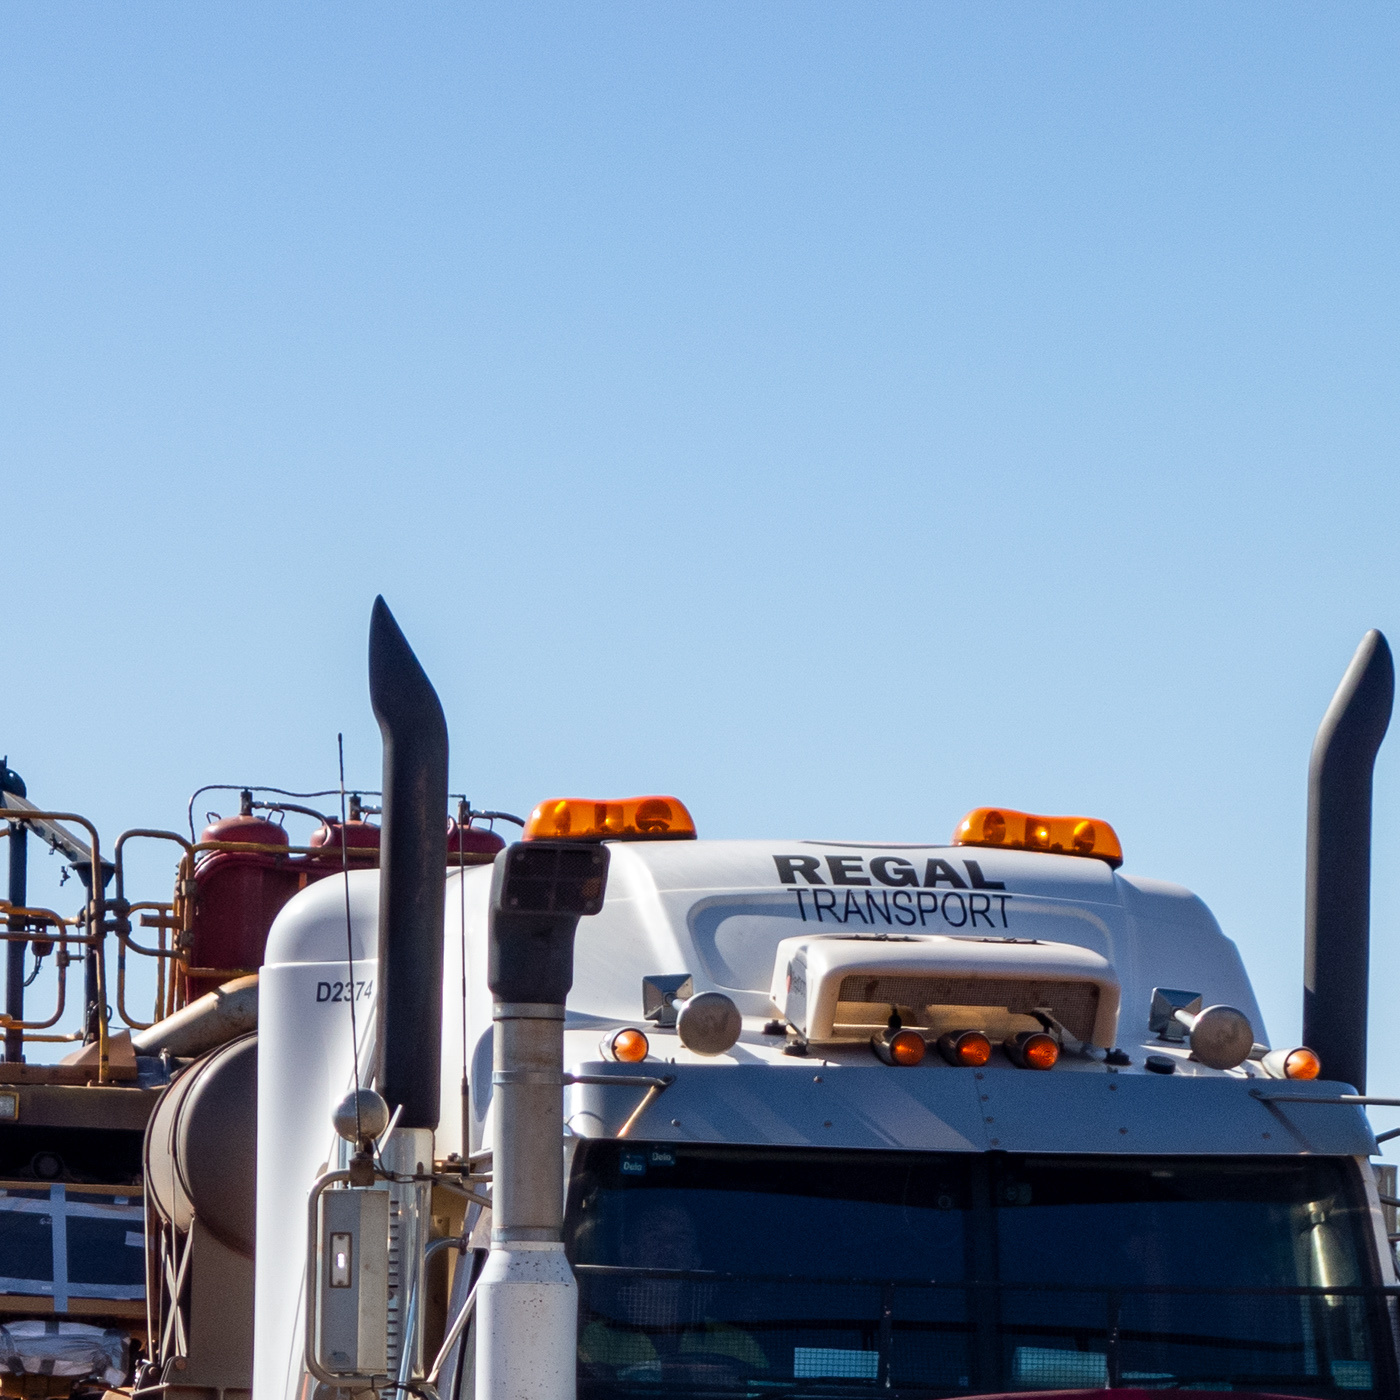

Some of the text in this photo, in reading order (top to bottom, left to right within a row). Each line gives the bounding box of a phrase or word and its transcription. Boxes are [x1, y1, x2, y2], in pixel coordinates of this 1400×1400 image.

[772, 854, 1006, 891] REGAL
[787, 887, 1013, 929] TRANSPORT
[316, 980, 374, 1003] D2374
